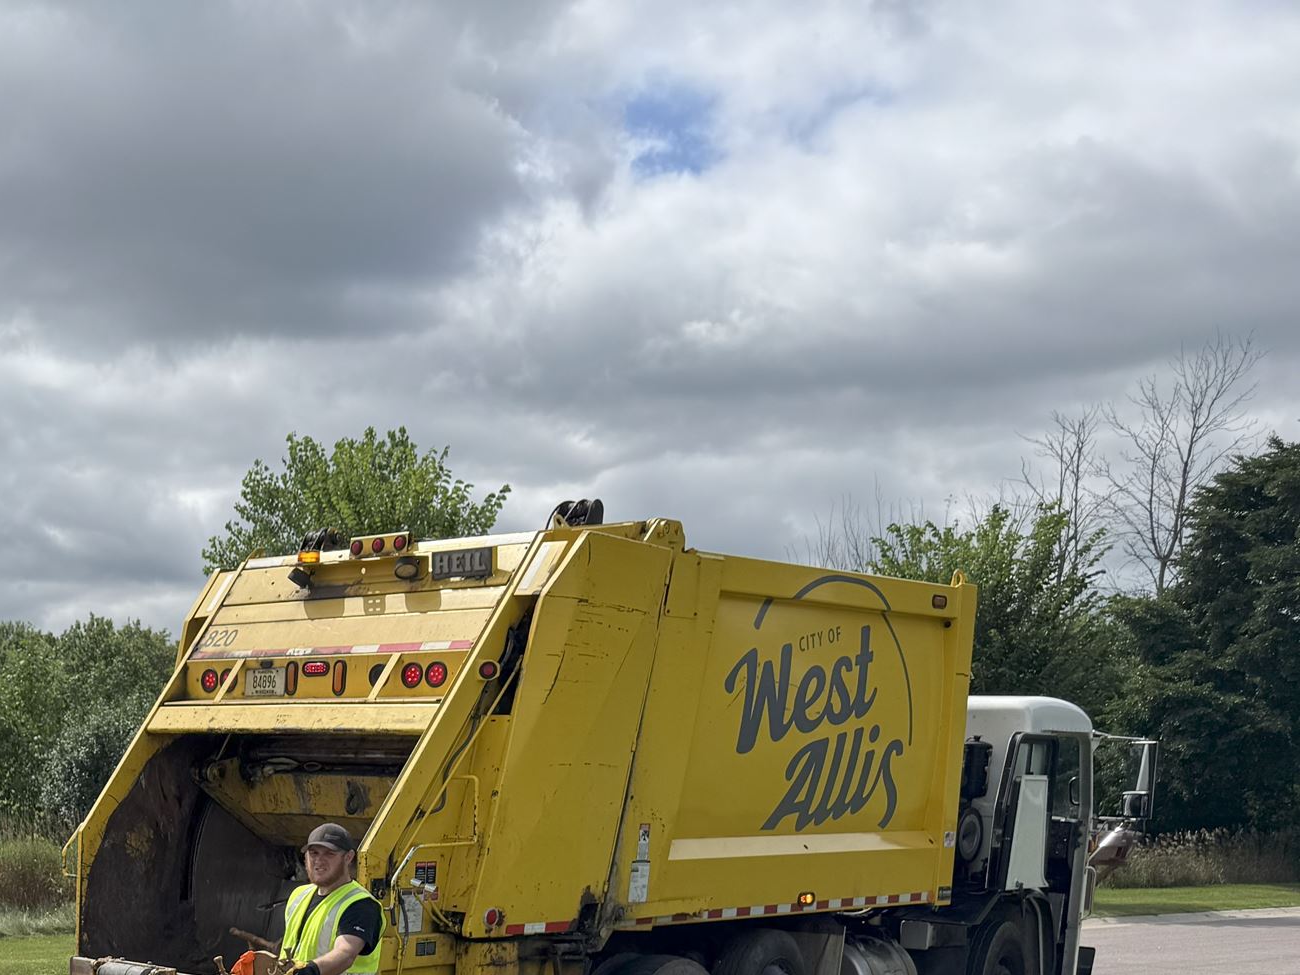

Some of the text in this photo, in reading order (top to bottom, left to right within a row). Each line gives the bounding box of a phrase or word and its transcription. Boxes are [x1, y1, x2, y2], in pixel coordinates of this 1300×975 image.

[435, 552, 486, 574] HEIL
[799, 626, 841, 651] CITY OF
[253, 675, 276, 688] 84896
[724, 625, 877, 754] West
[760, 725, 903, 831] Allis
